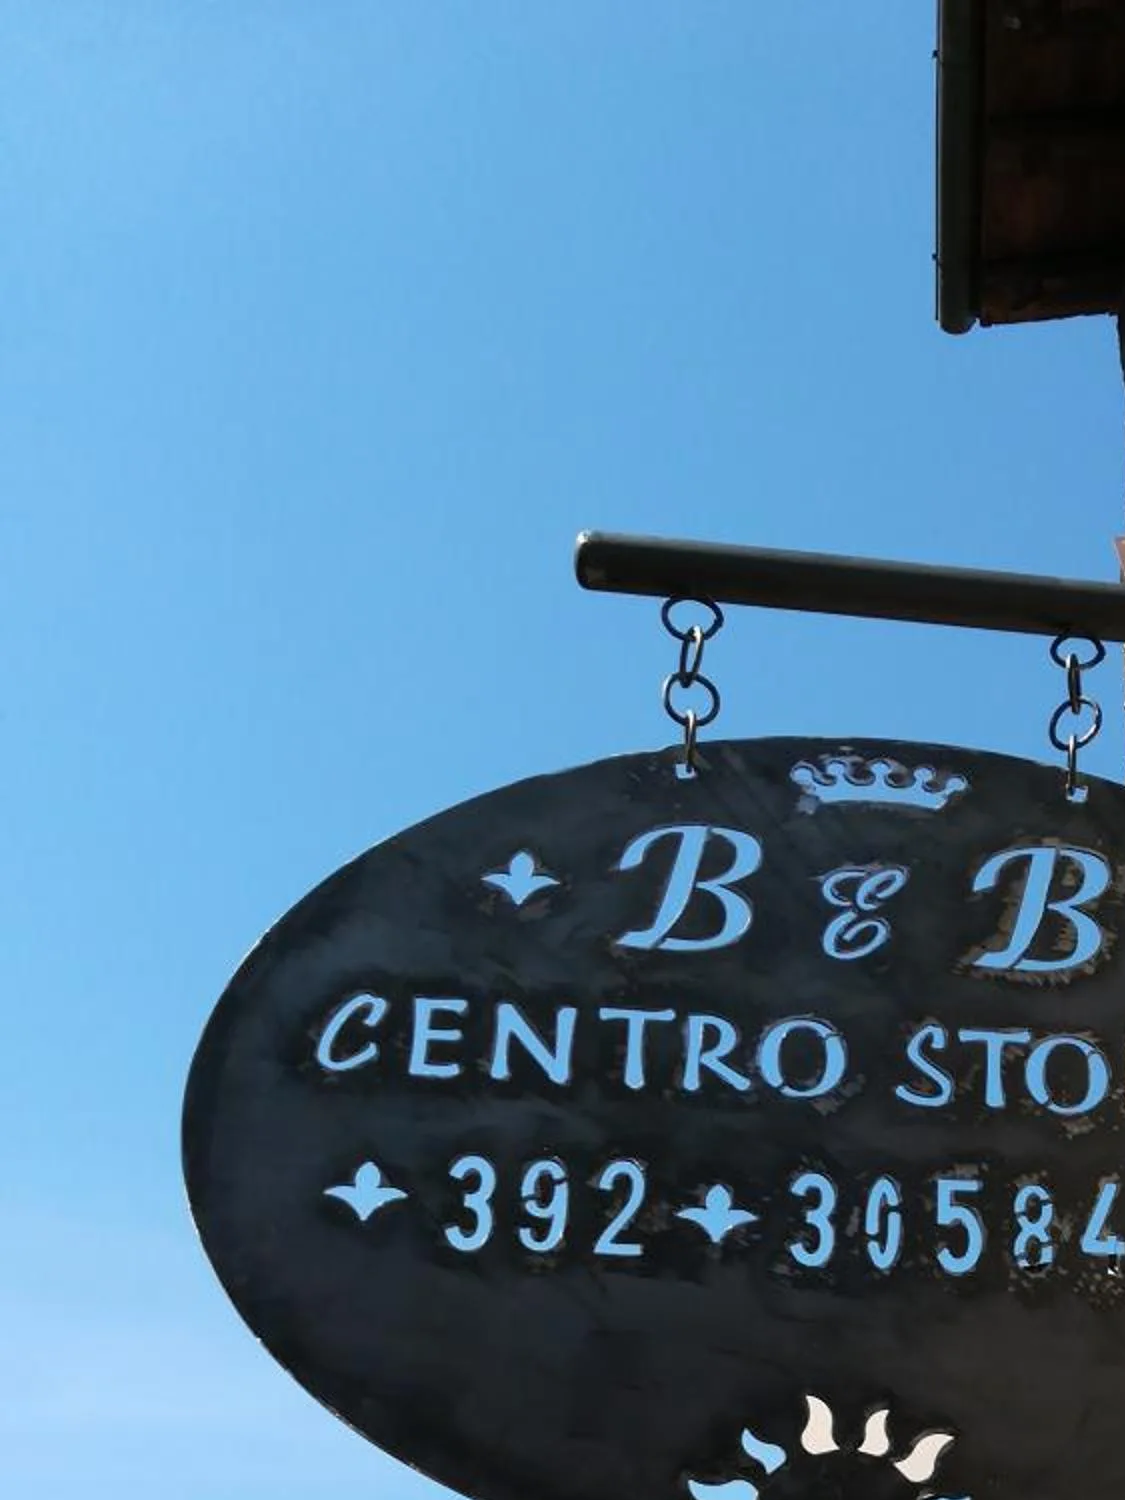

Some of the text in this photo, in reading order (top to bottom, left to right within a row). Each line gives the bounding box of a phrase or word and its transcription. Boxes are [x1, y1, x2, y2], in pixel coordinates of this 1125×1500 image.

[616, 823, 762, 951] B
[971, 844, 1112, 972] B
[316, 992, 847, 1099] CENTRO
[445, 1155, 647, 1256] 392
